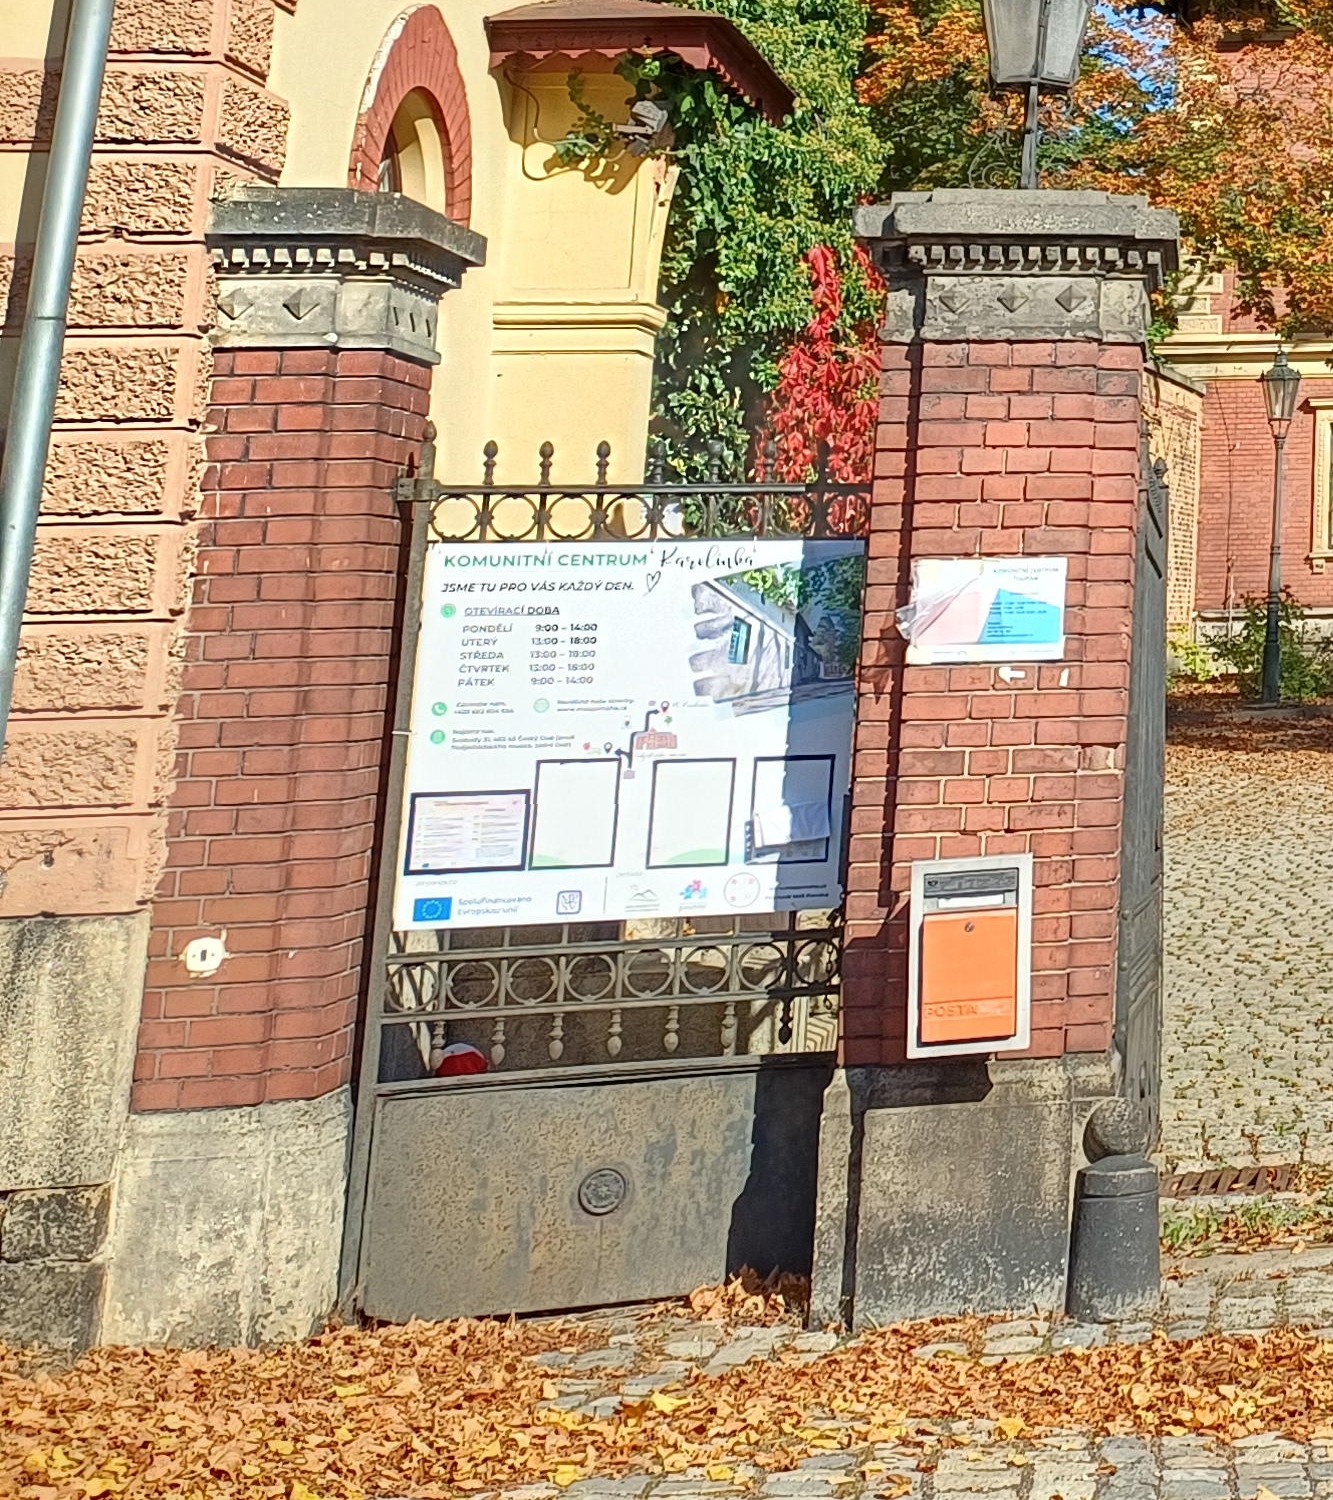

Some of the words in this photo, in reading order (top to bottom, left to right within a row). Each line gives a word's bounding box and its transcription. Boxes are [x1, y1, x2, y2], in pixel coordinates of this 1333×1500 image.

[443, 552, 553, 567] KOMUNITNÍ
[557, 554, 647, 567] CENTRUM
[441, 583, 475, 592] JSME
[480, 583, 496, 592] TU
[499, 582, 527, 592] PRO
[531, 580, 555, 591] VÁS
[559, 580, 602, 591] KAŽDÝ
[605, 581, 634, 591] DEN.
[464, 605, 524, 616] OTEVÍRACÍ
[527, 606, 560, 615] DOBA
[462, 623, 513, 633] PONDĚLÍ
[535, 624, 559, 632] 9:00
[570, 623, 598, 631] 14:00
[570, 636, 597, 644] 18:00
[457, 676, 495, 687] PÁTEK
[566, 676, 593, 684] 14:00
